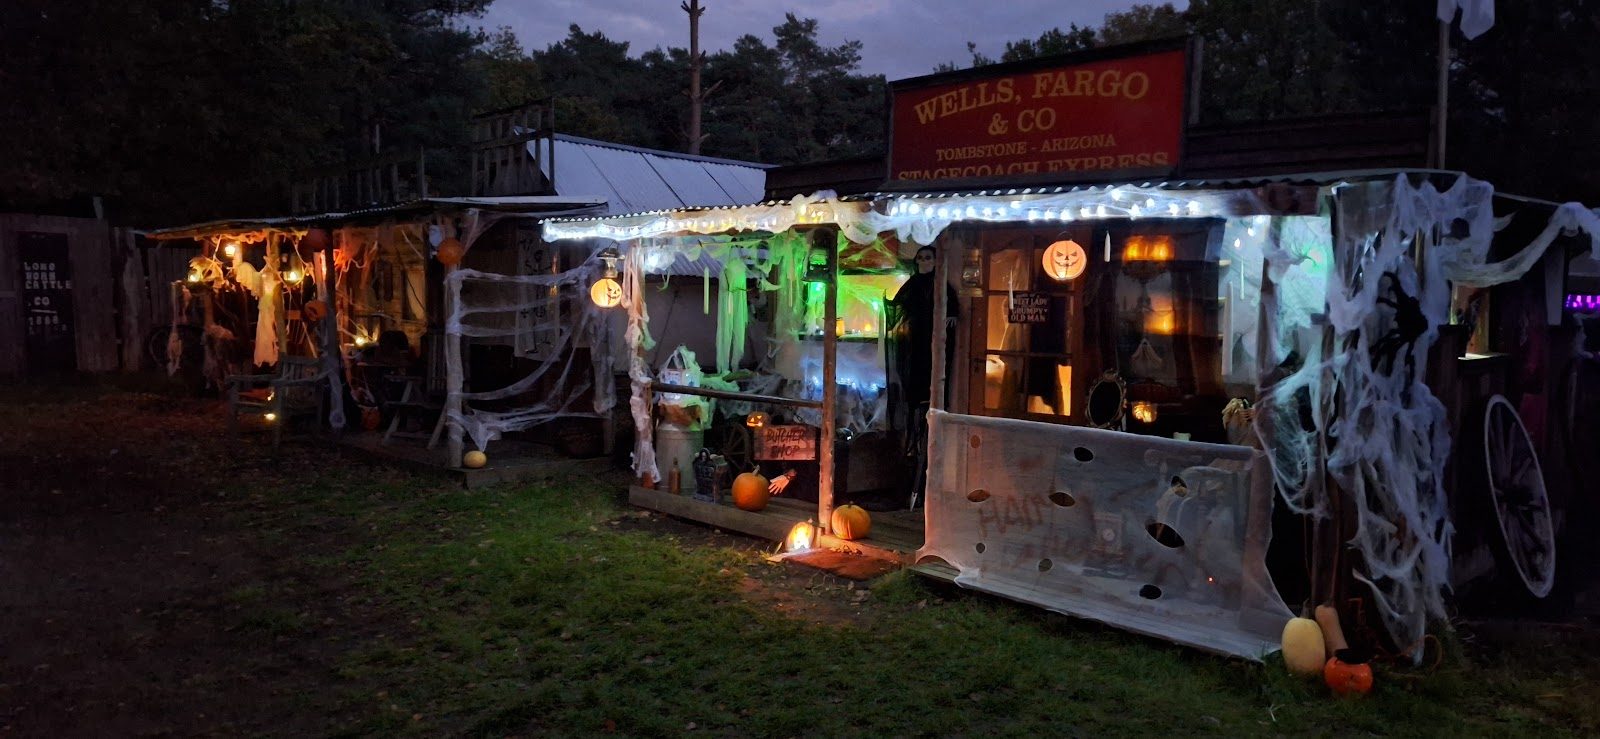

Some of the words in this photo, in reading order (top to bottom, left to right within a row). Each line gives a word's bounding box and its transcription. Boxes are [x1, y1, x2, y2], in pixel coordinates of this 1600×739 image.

[913, 78, 1022, 125] WELLS,
[1032, 69, 1149, 99] FARGO
[987, 112, 1009, 135] &
[1017, 107, 1056, 132] CO
[936, 141, 1027, 162] TOMBSTONE
[1041, 133, 1117, 152] ARIZONA
[25, 271, 56, 281] HORN
[25, 280, 72, 290] CATTLE
[766, 427, 805, 443] BUTCHER
[770, 443, 800, 459] SHOP
